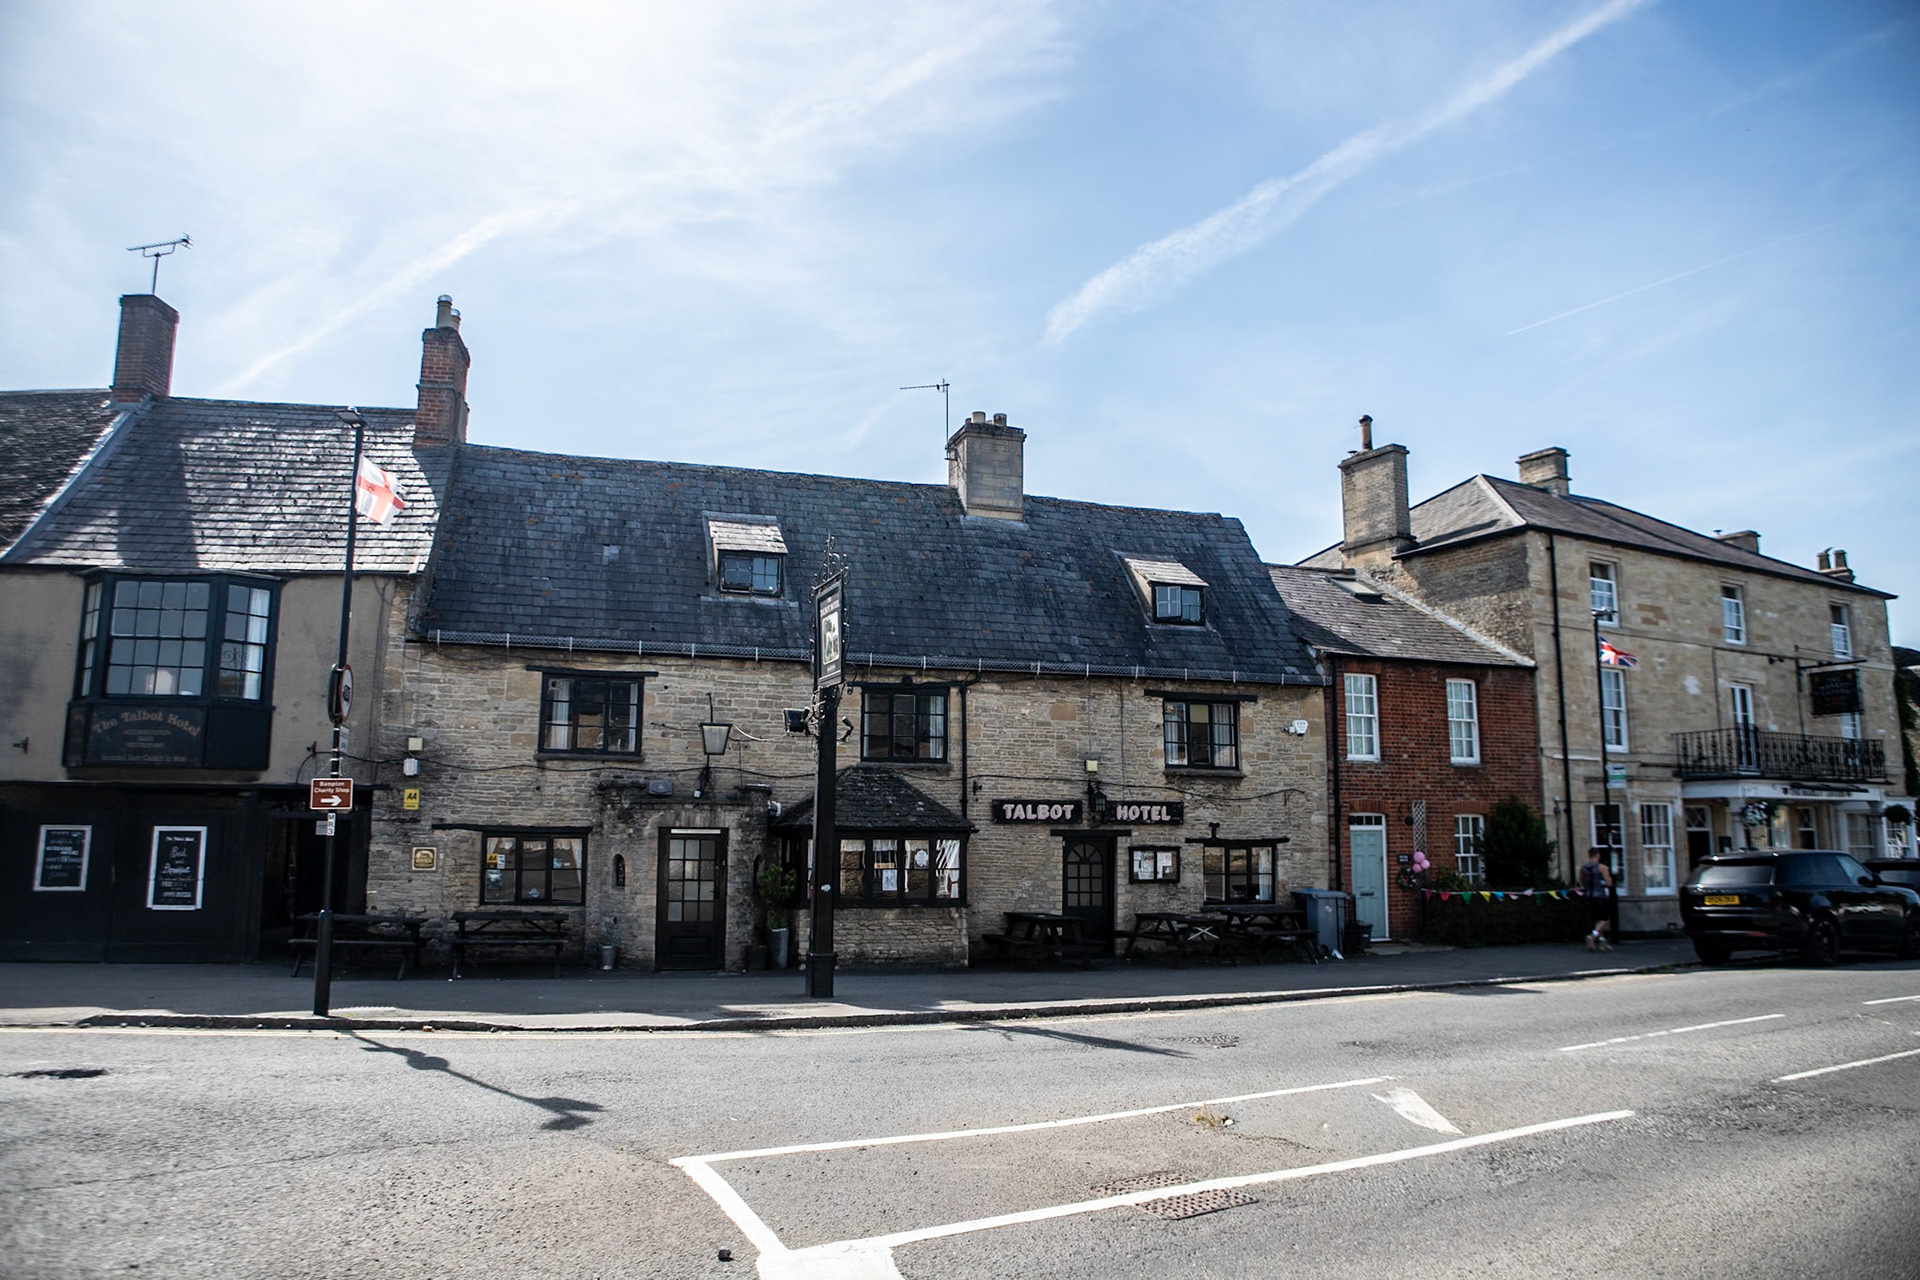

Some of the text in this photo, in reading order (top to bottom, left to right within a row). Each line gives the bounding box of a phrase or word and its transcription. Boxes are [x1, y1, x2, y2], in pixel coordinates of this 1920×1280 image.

[92, 710, 201, 737] The Talbot Hotel
[1002, 804, 1172, 821] TALBOT HOTEL
